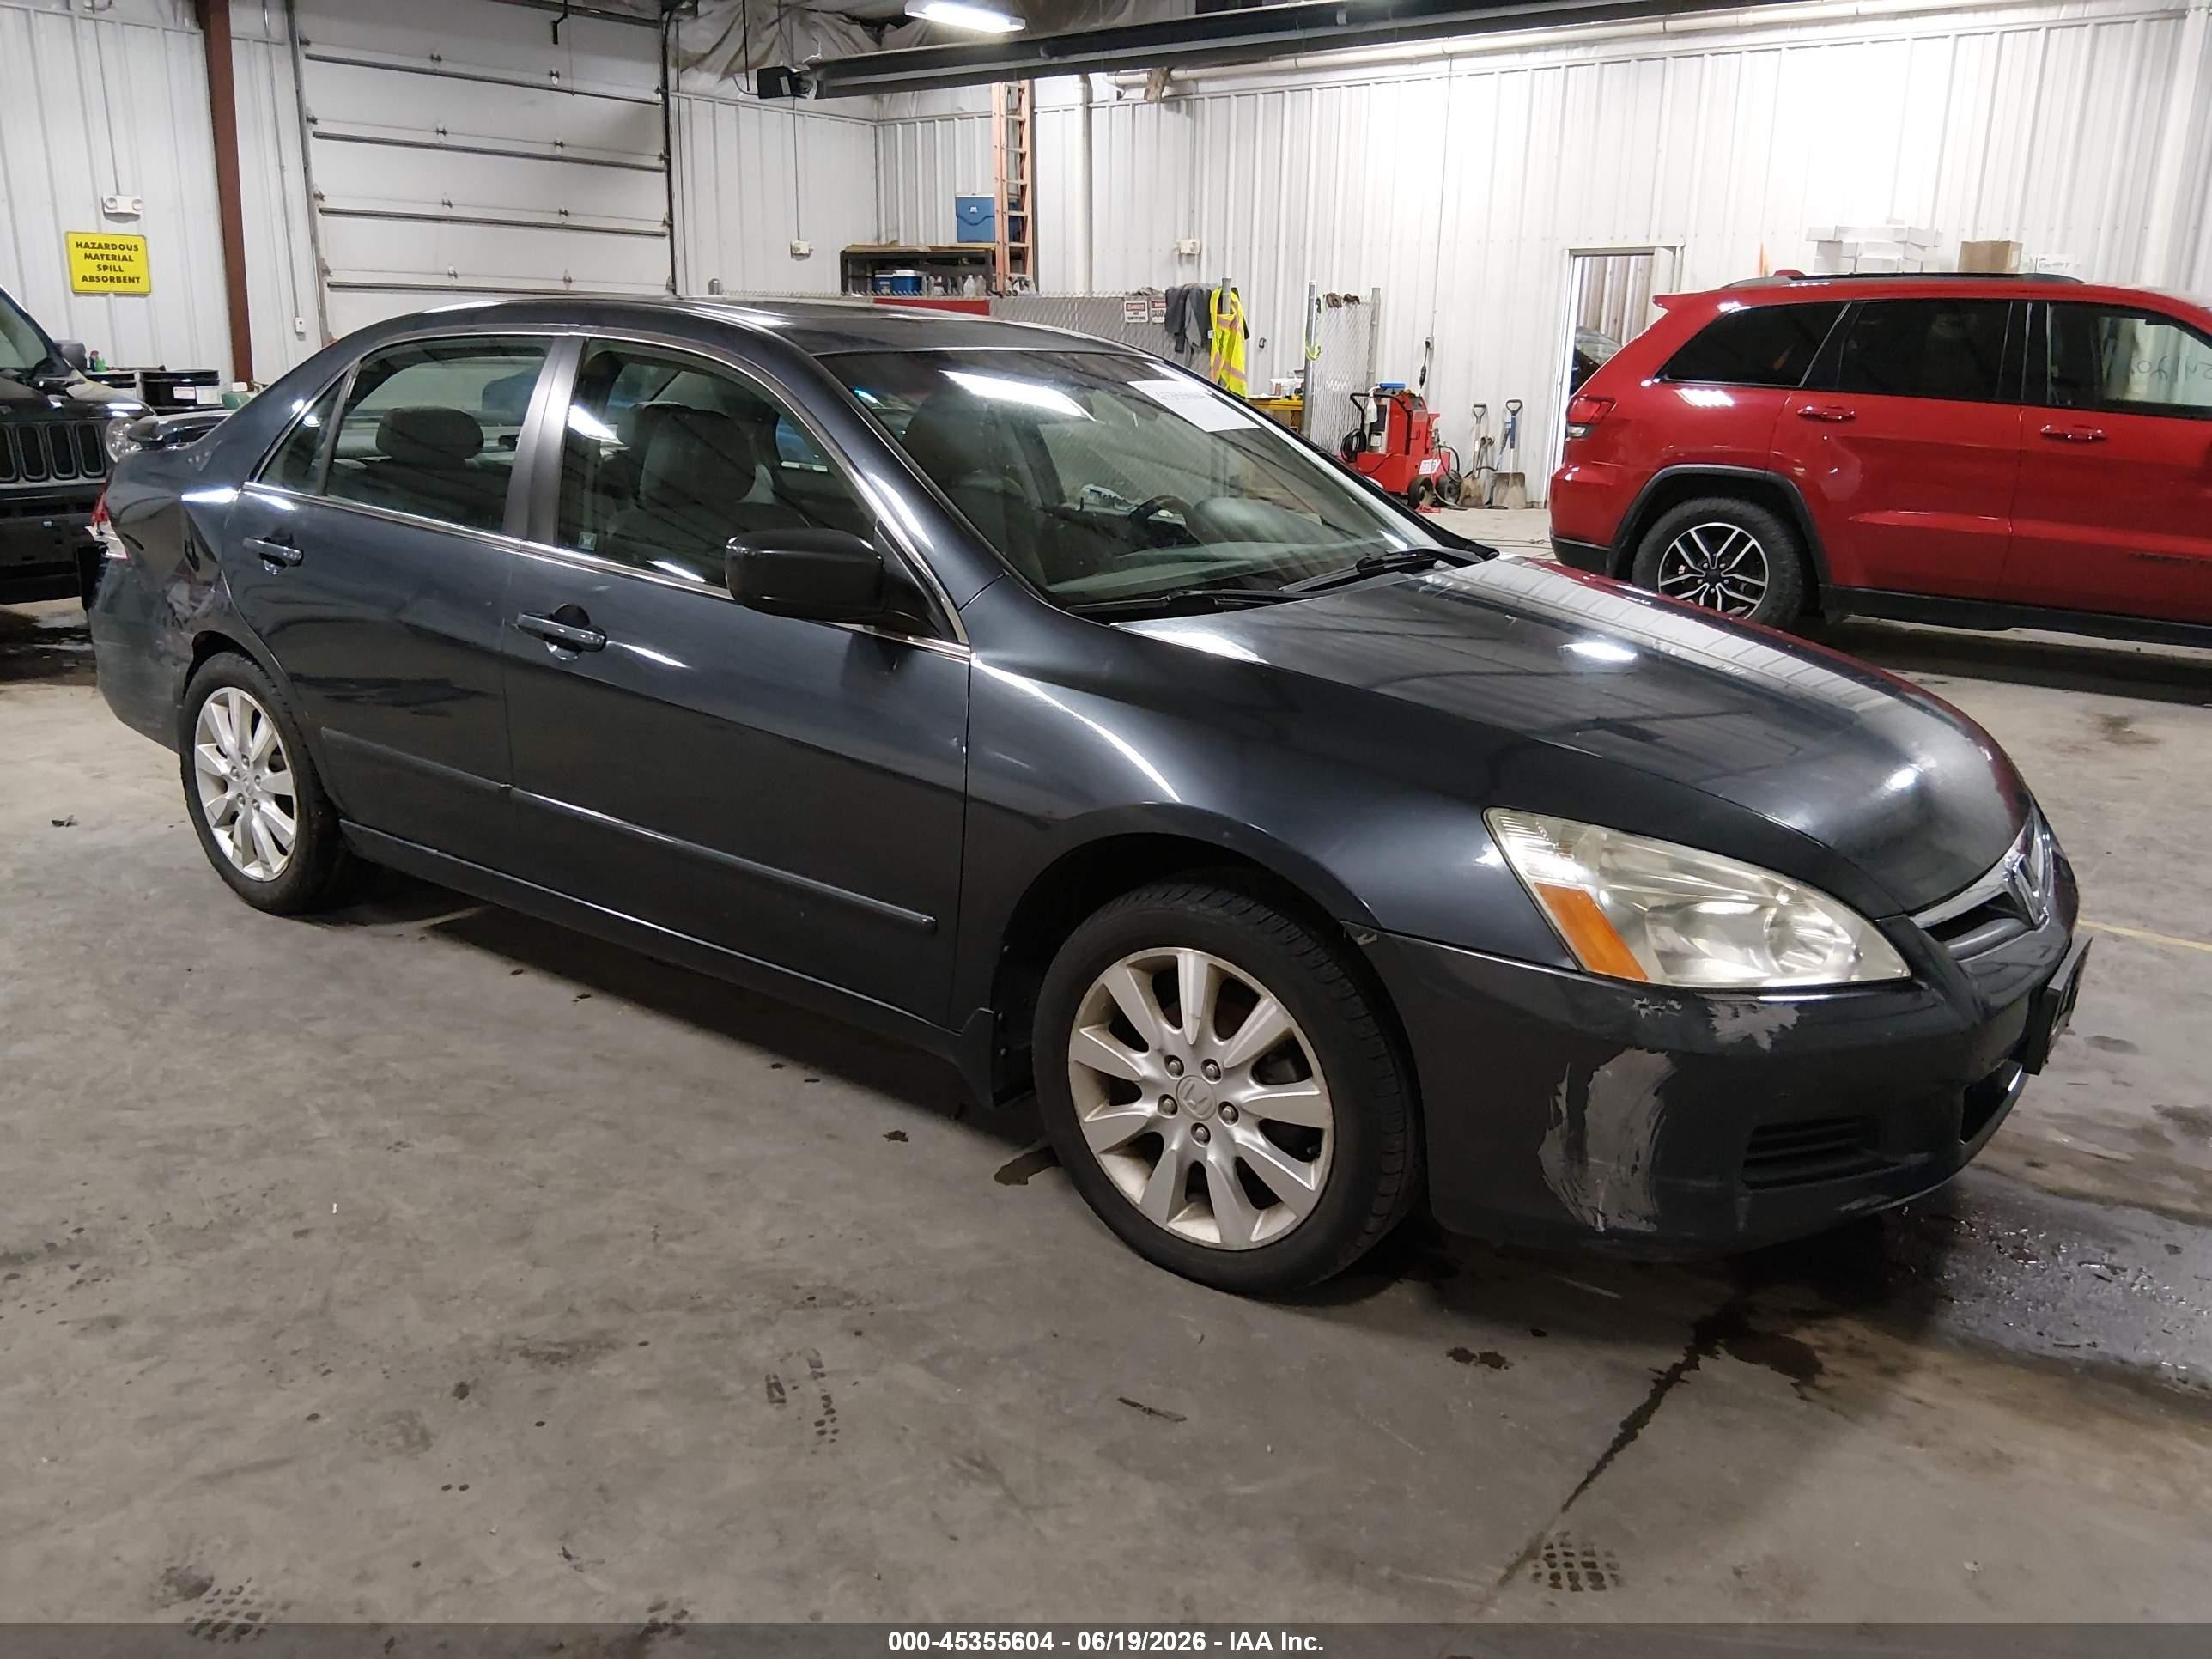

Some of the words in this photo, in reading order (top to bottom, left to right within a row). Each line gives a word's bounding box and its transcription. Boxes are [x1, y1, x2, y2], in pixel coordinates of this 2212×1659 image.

[76, 241, 139, 252] HAZARDOUS
[84, 253, 134, 262] MATERIAL
[82, 275, 141, 283] ABSORBENT
